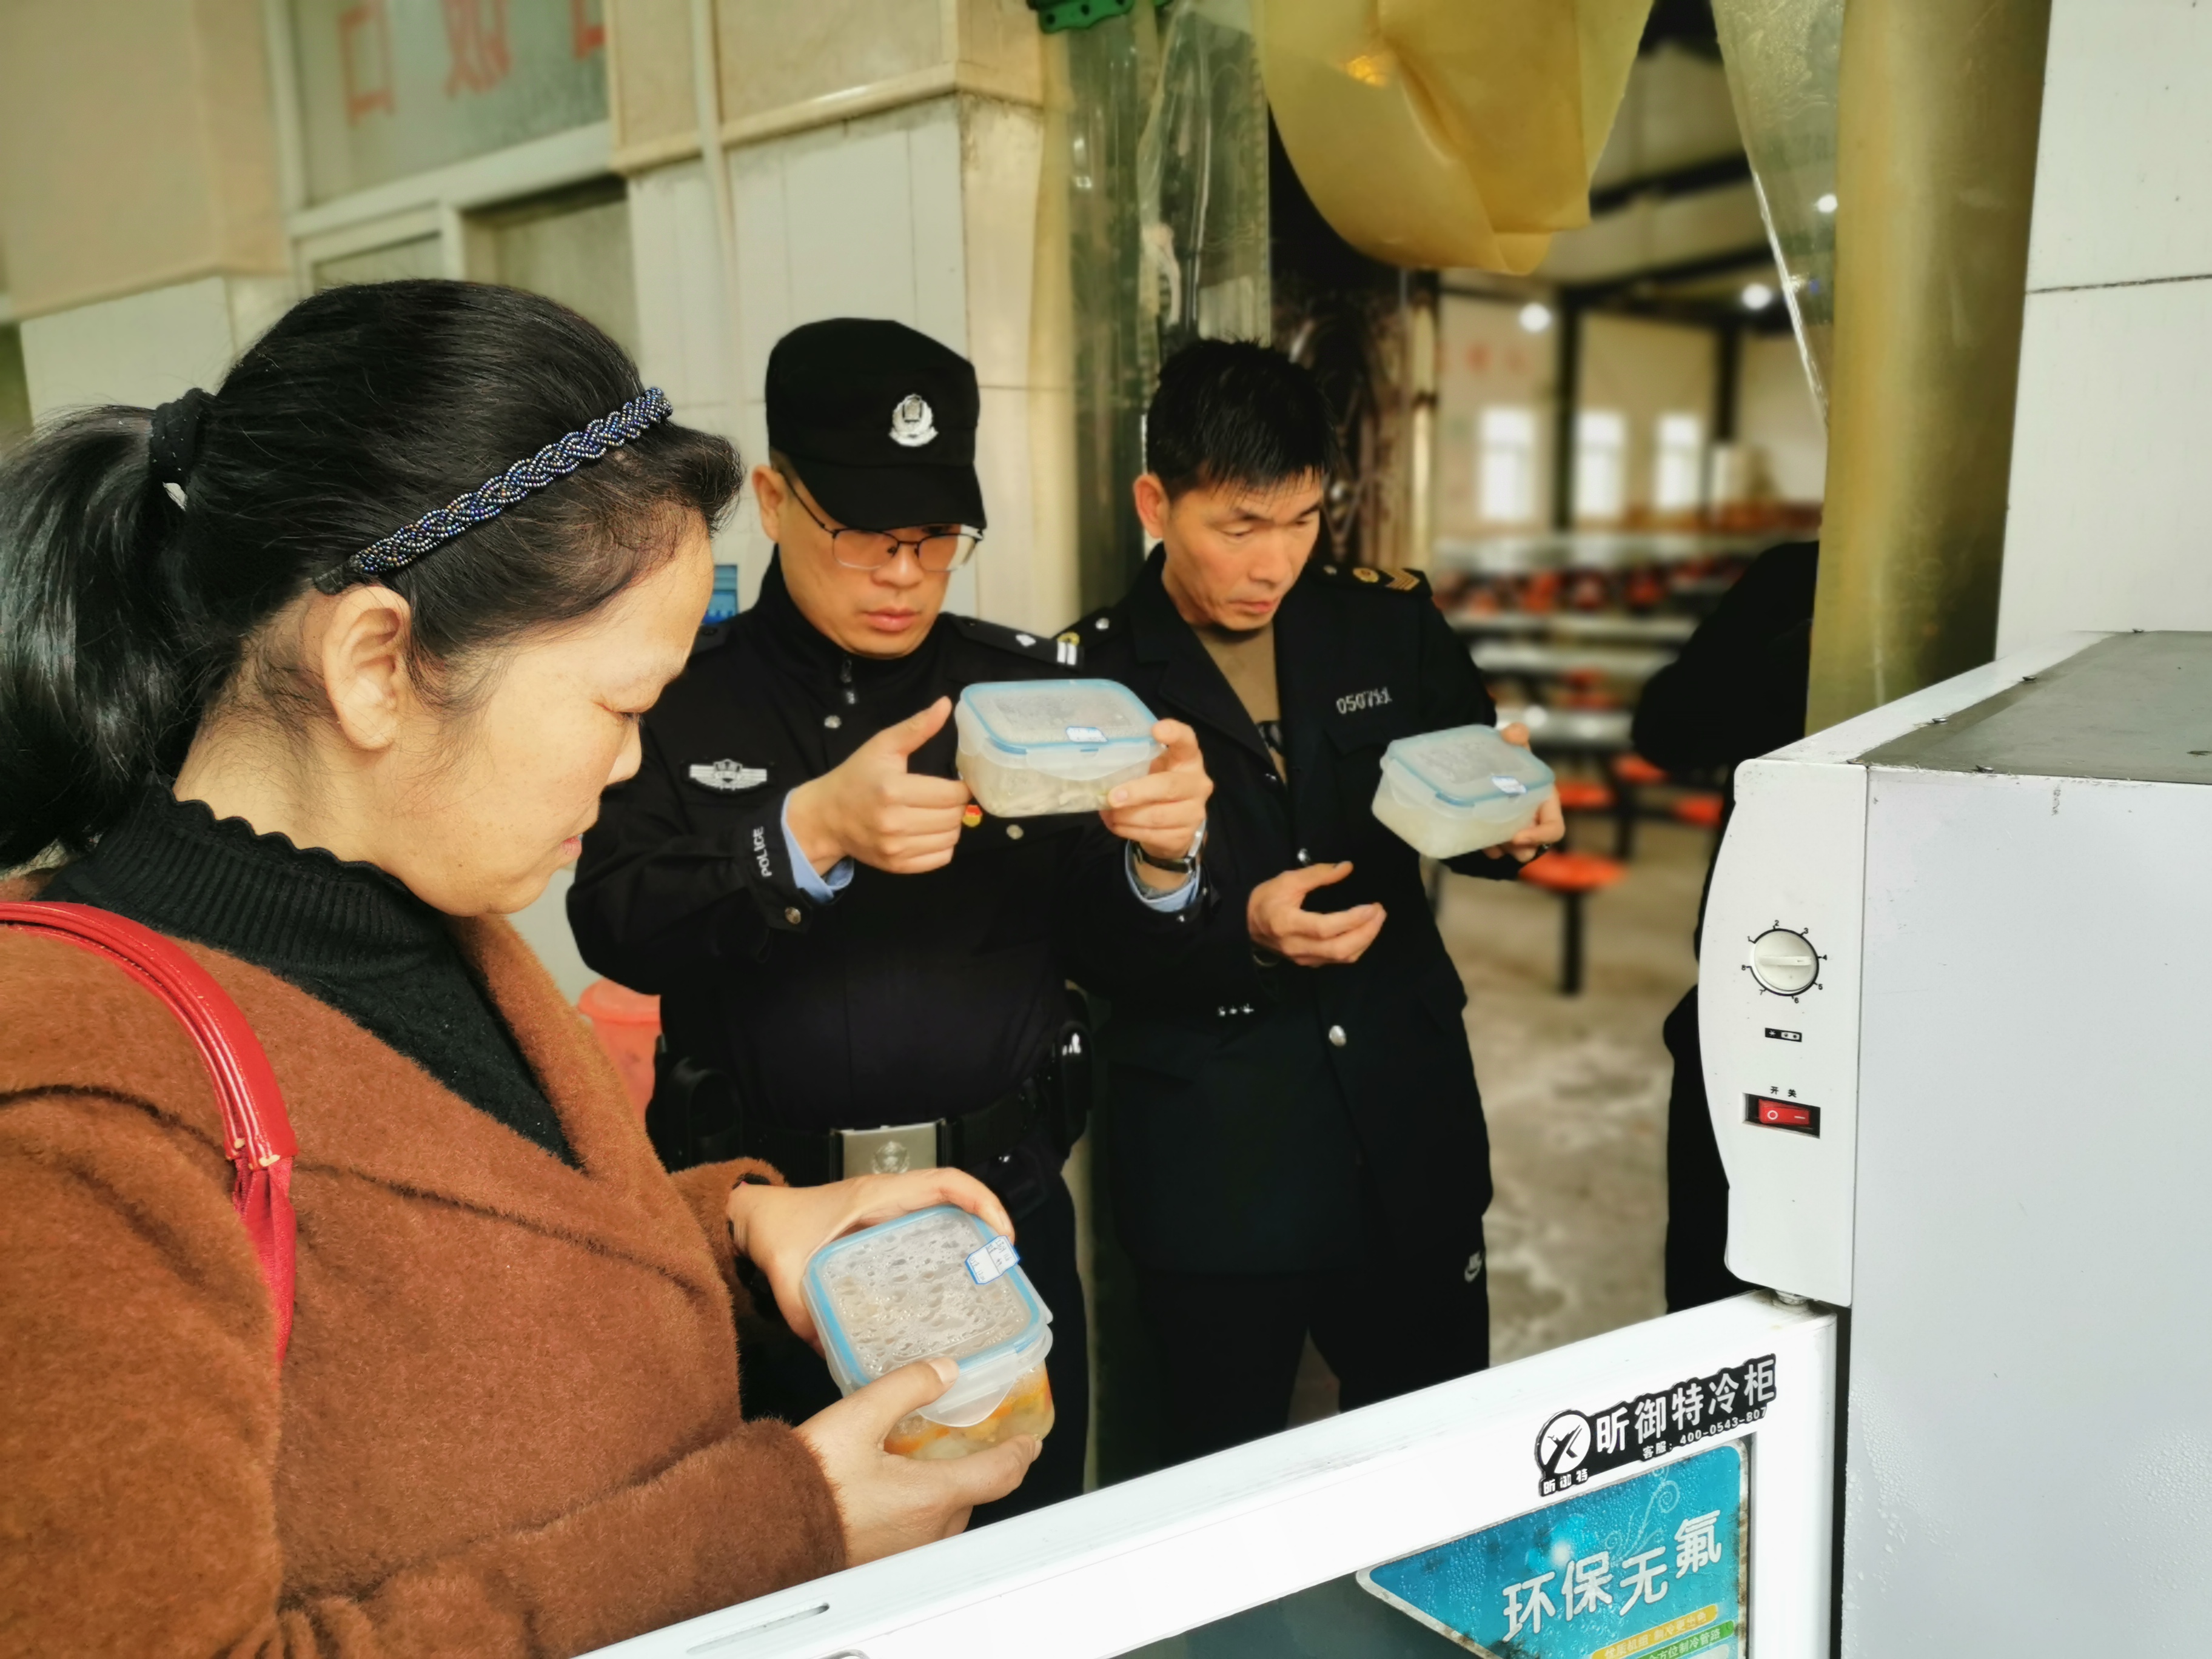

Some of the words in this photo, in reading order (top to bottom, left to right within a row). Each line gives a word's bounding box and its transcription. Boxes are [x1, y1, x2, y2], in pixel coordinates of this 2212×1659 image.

[753, 826, 773, 877] POLICE
[1770, 1085, 1797, 1098] 开关
[1596, 1358, 1775, 1455] 昕御特冷柜
[1679, 1406, 1768, 1446] 400-0543-807
[1502, 1509, 1722, 1642] 环保无氟
